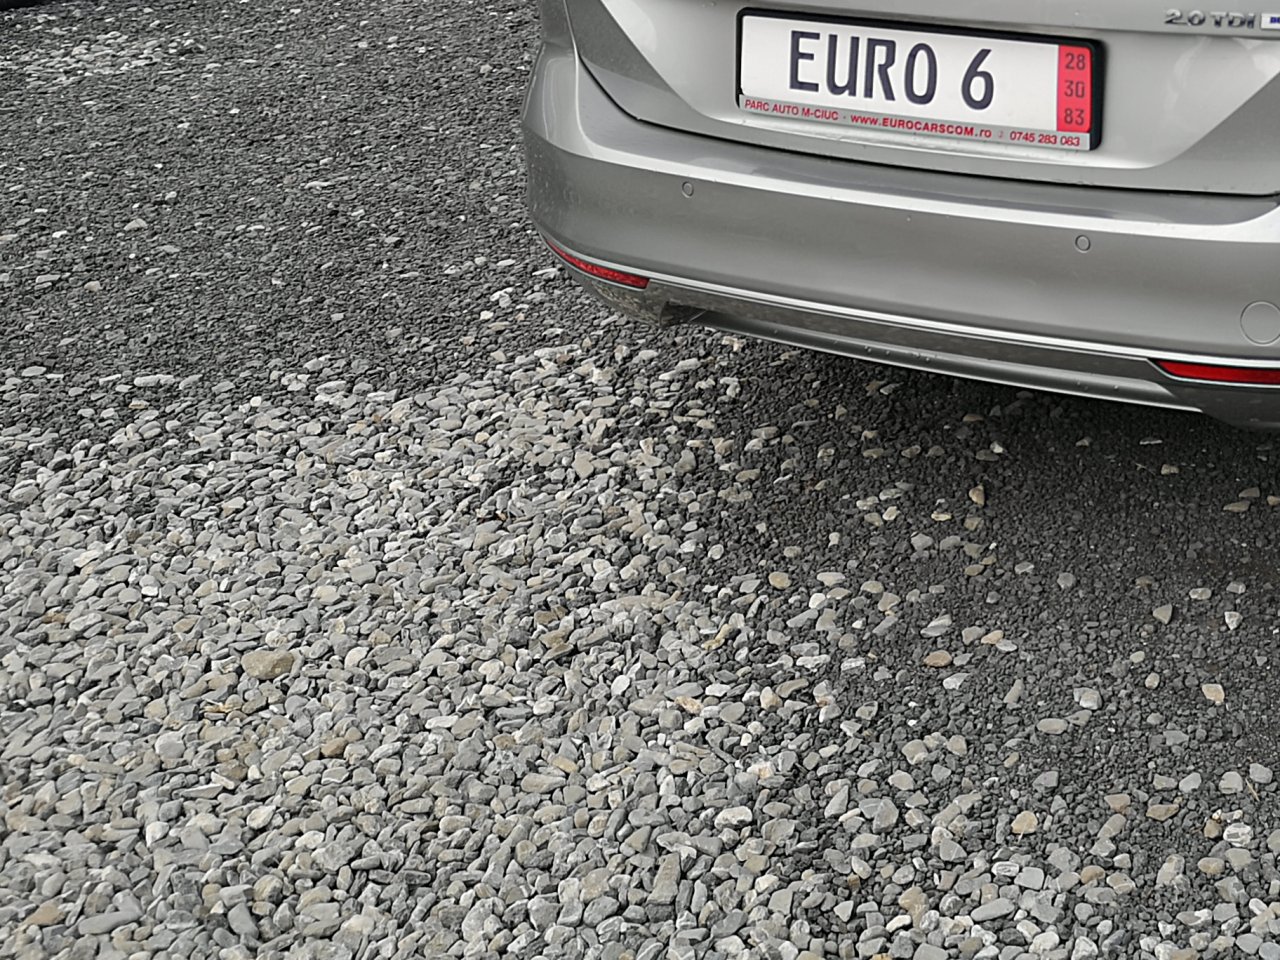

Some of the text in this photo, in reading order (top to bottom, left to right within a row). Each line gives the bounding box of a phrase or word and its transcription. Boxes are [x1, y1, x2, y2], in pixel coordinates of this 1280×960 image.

[1209, 11, 1256, 29] TDI
[789, 29, 995, 111] EURO 6
[1065, 52, 1086, 71] 28
[1064, 80, 1085, 98] 30
[744, 99, 770, 112] PARC
[772, 103, 799, 116] AUTO
[801, 106, 839, 120] M-CIUC
[850, 114, 992, 139] www.EUROCARSCOM.ro
[1009, 130, 1036, 144] 0745
[1064, 108, 1085, 126] 83
